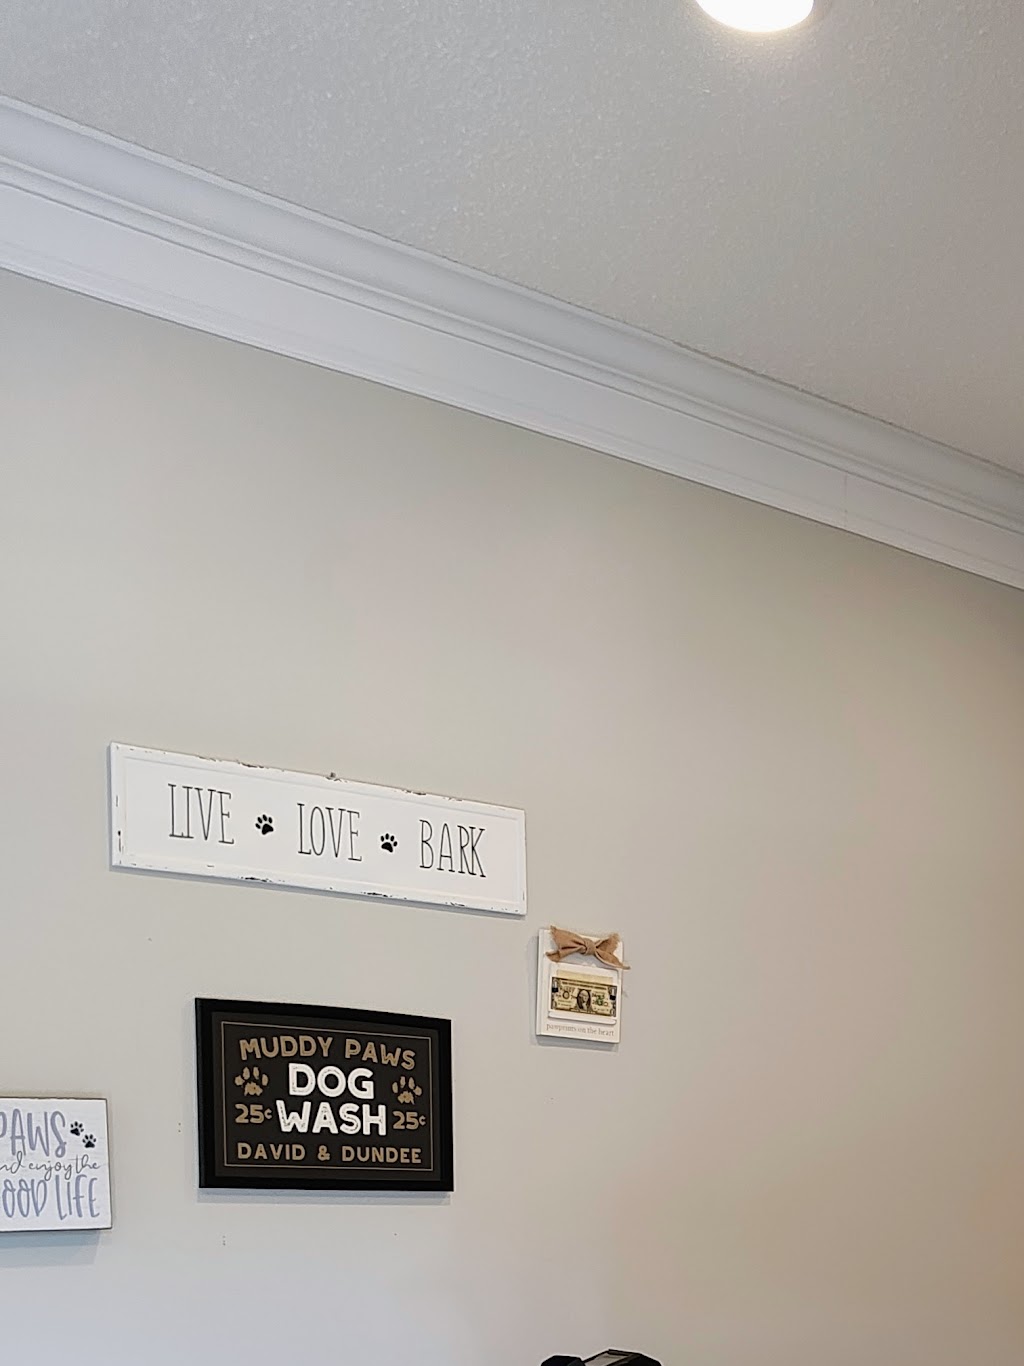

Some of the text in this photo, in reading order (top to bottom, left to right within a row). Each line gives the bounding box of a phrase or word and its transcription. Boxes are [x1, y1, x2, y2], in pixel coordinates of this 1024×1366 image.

[168, 783, 486, 878] LIVE LOVE BARK
[587, 1026, 597, 1035] the
[239, 1035, 416, 1070] MUDDY PAWS
[288, 1062, 374, 1099] DOG
[275, 1099, 387, 1136] WASH
[0, 1151, 101, 1181] nd enjoy the
[237, 1142, 422, 1164] DAVID & DUNDEE
[0, 1174, 100, 1220] OOD LIFE
